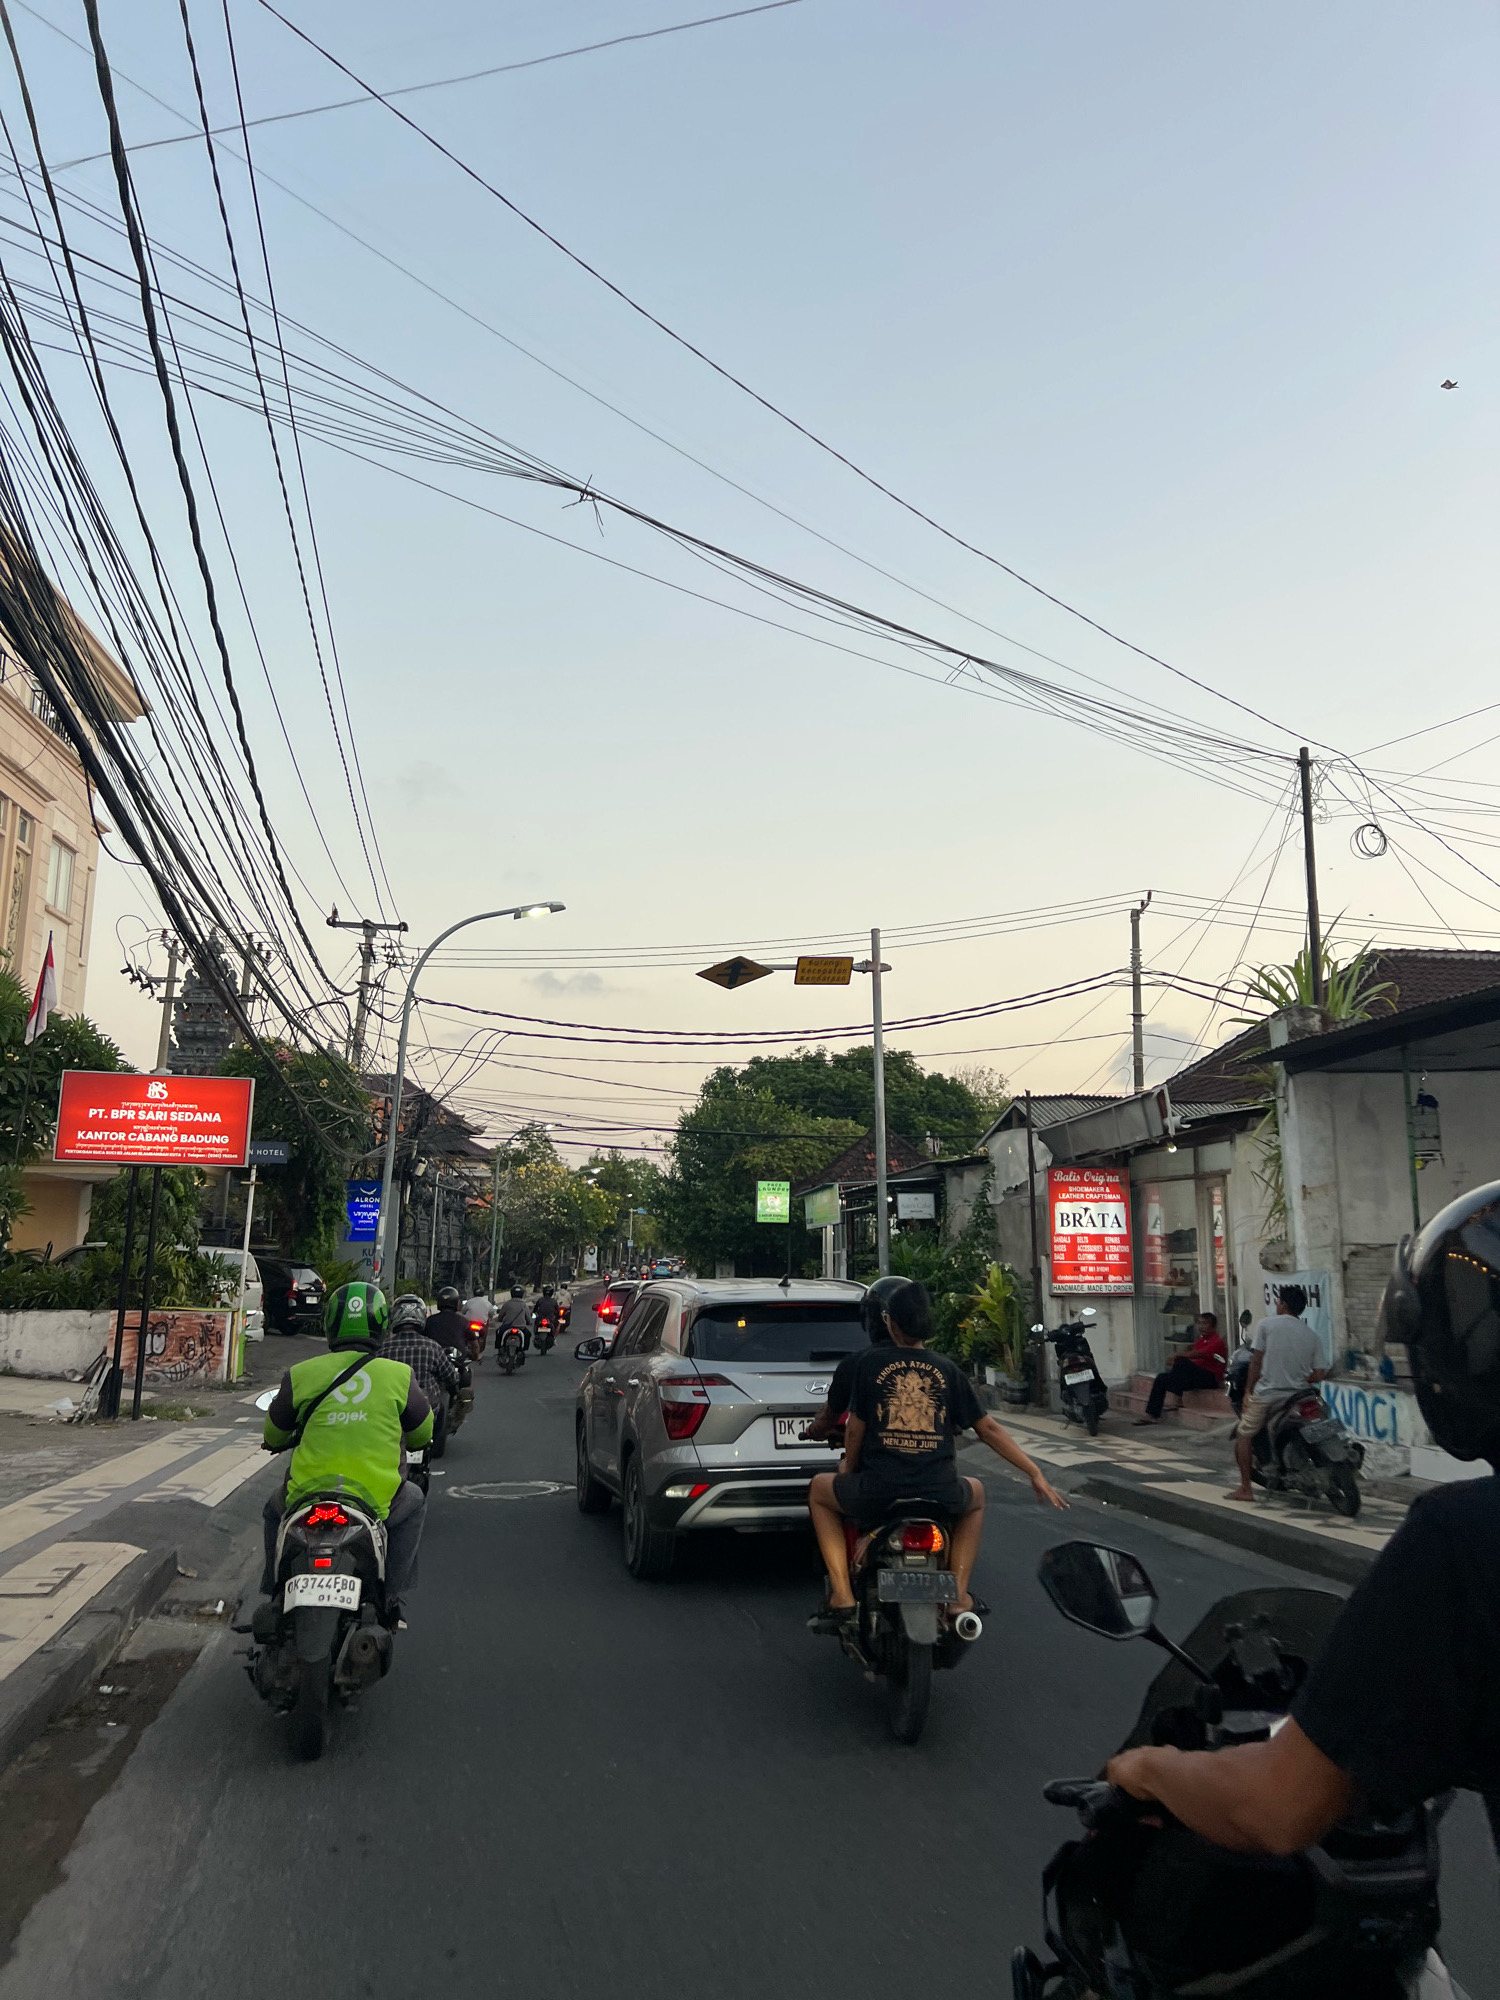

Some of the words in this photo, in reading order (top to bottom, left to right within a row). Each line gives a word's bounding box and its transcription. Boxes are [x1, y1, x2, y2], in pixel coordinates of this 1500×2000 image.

[88, 1108, 108, 1119] PT.
[110, 1109, 136, 1120] BPR
[137, 1110, 167, 1121] SARI
[169, 1111, 222, 1123] SEDANA
[77, 1130, 126, 1141] KANTOR
[127, 1132, 179, 1143] CABANG
[180, 1133, 229, 1144] BADUNG
[1053, 1170, 1081, 1182] Balis
[1059, 1212, 1123, 1228] BRATA
[1104, 1236, 1121, 1244] REPAIRS
[1104, 1245, 1130, 1253] ALTERATIONS
[1077, 1253, 1097, 1261] CLOTHING
[1113, 1284, 1133, 1293] ORDER
[876, 1361, 907, 1385] PENDOSA
[909, 1360, 932, 1371] ATAU
[932, 1367, 947, 1389] TIDAK
[327, 1410, 368, 1424] gojek
[778, 1419, 795, 1435] DK
[883, 1437, 917, 1448] MENJADI
[919, 1440, 938, 1449] JURI
[880, 1571, 896, 1586] DK
